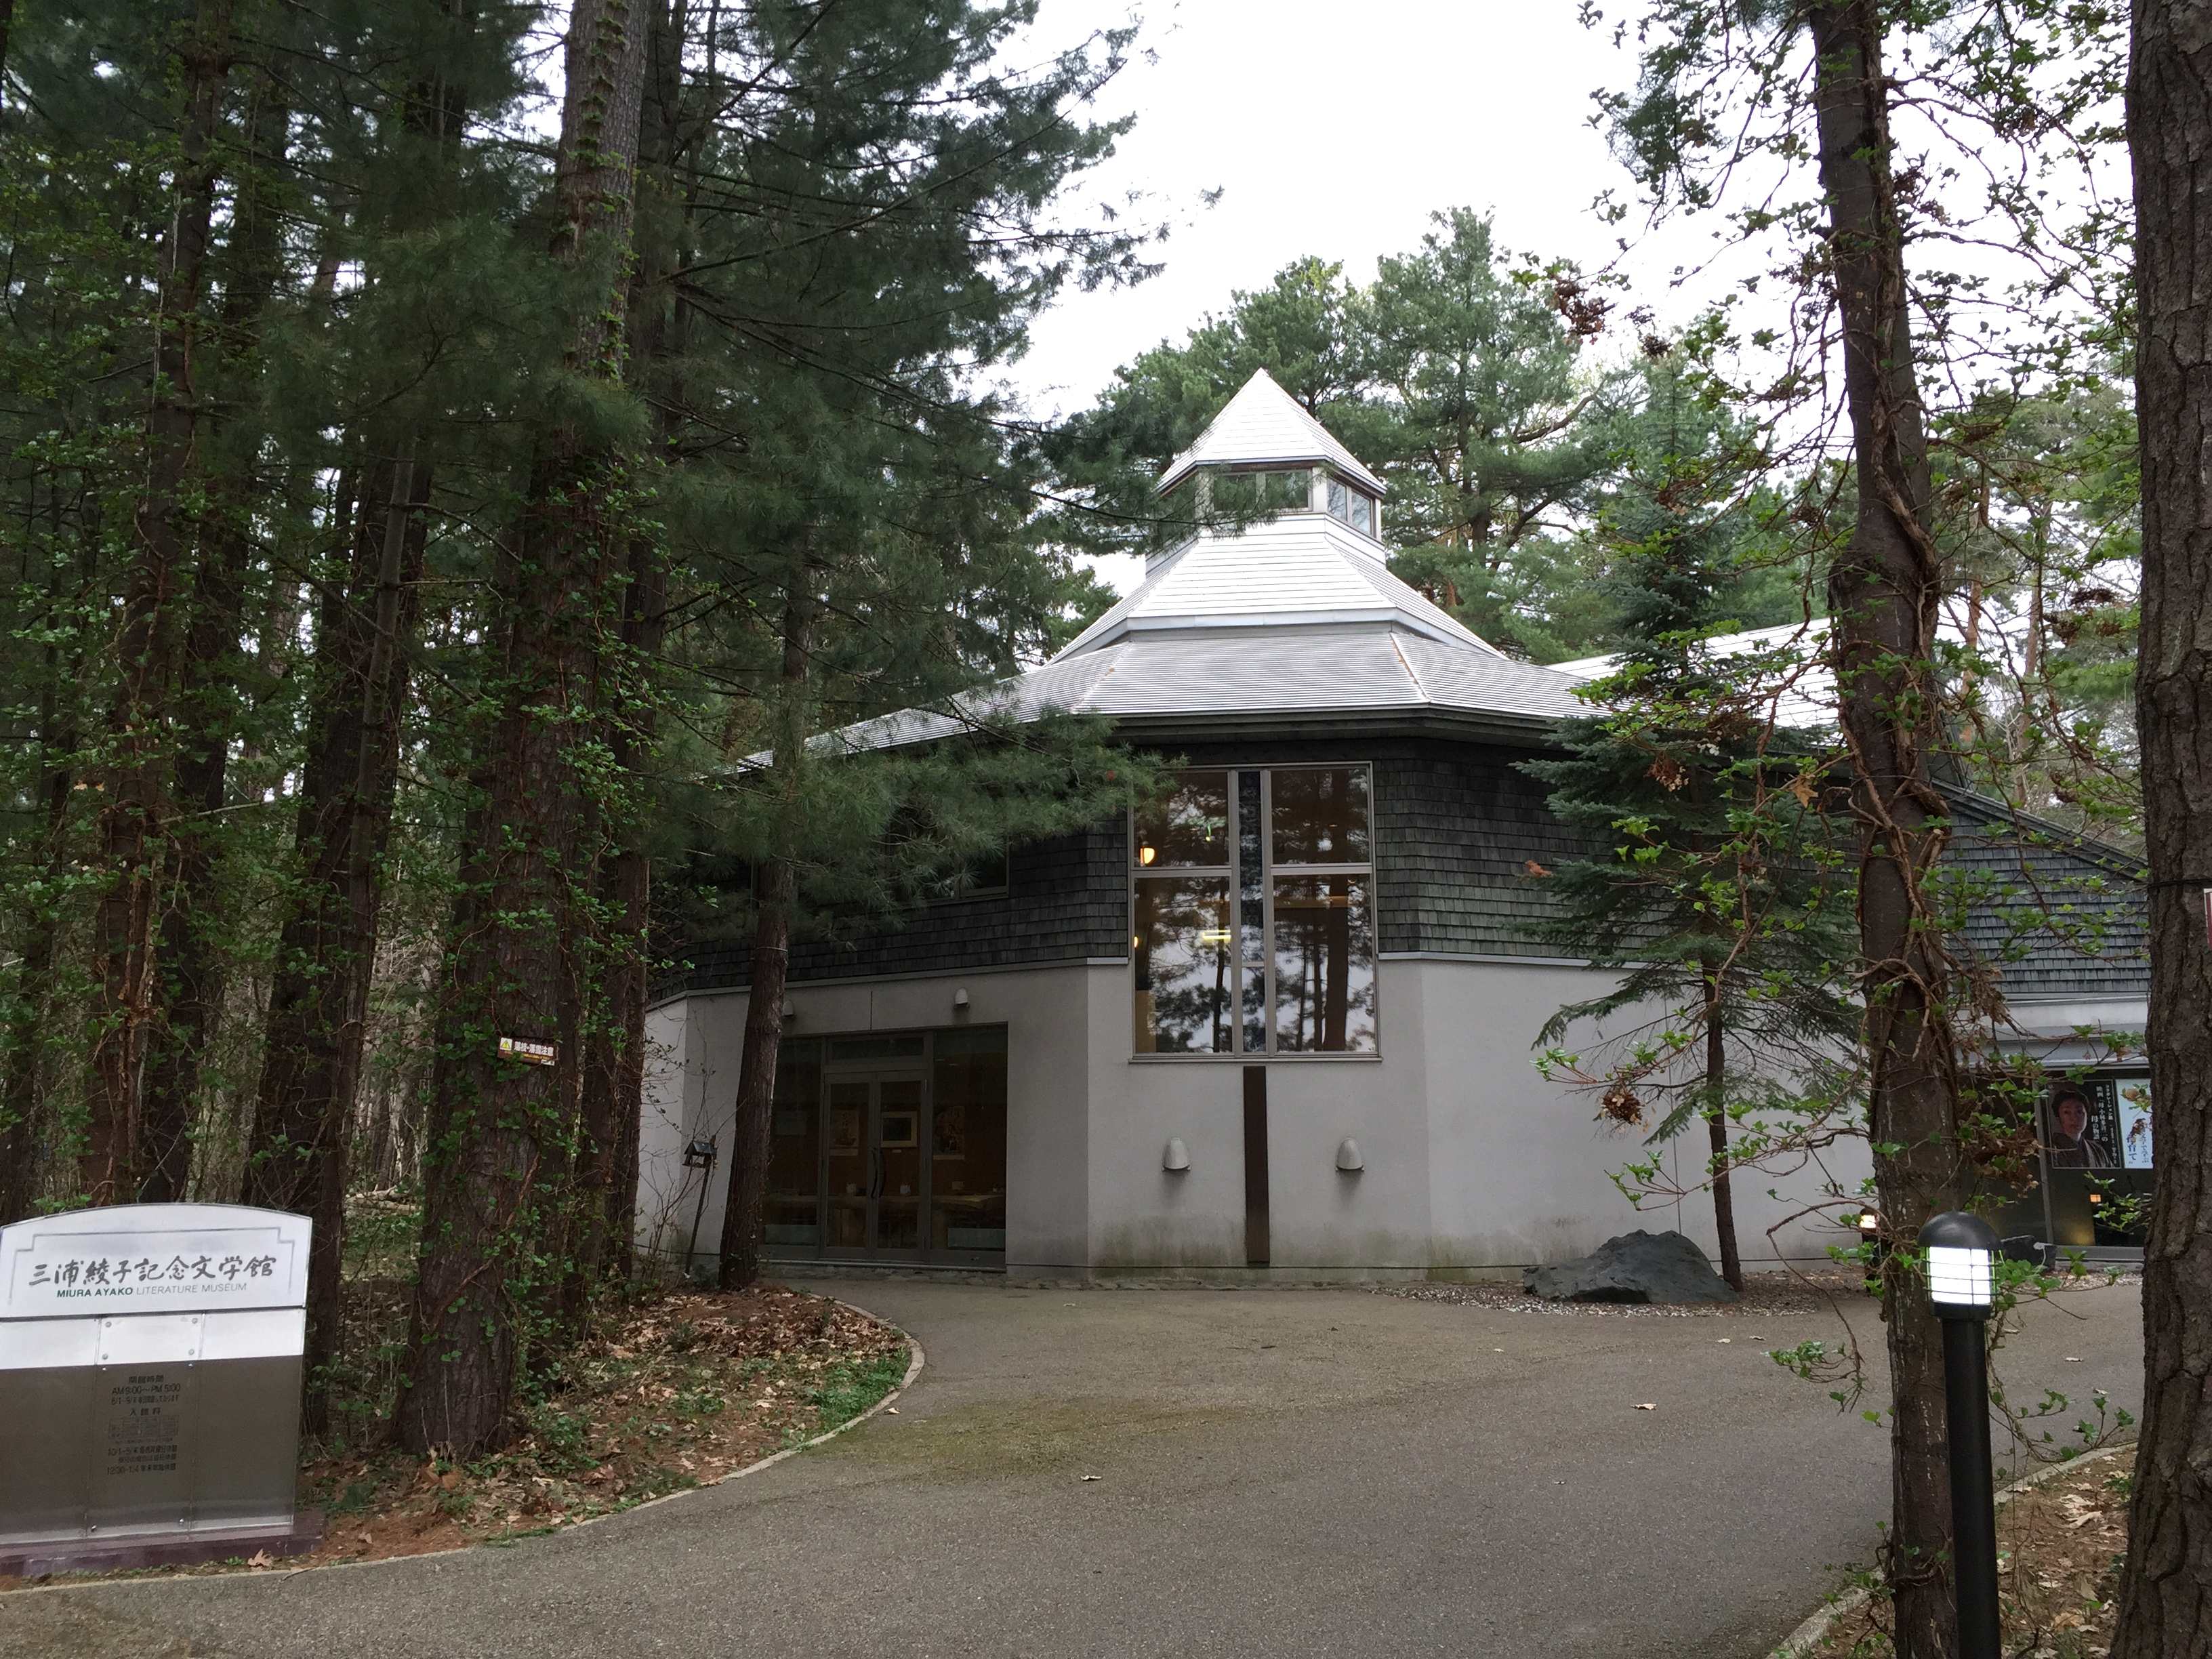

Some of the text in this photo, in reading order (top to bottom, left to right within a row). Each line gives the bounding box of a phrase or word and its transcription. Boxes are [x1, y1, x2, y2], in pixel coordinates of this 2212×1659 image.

[28, 1255, 276, 1287] 三浦綾子記念文学館
[56, 1282, 247, 1298] MIURA AYAKO LITERATURE MUSEUM
